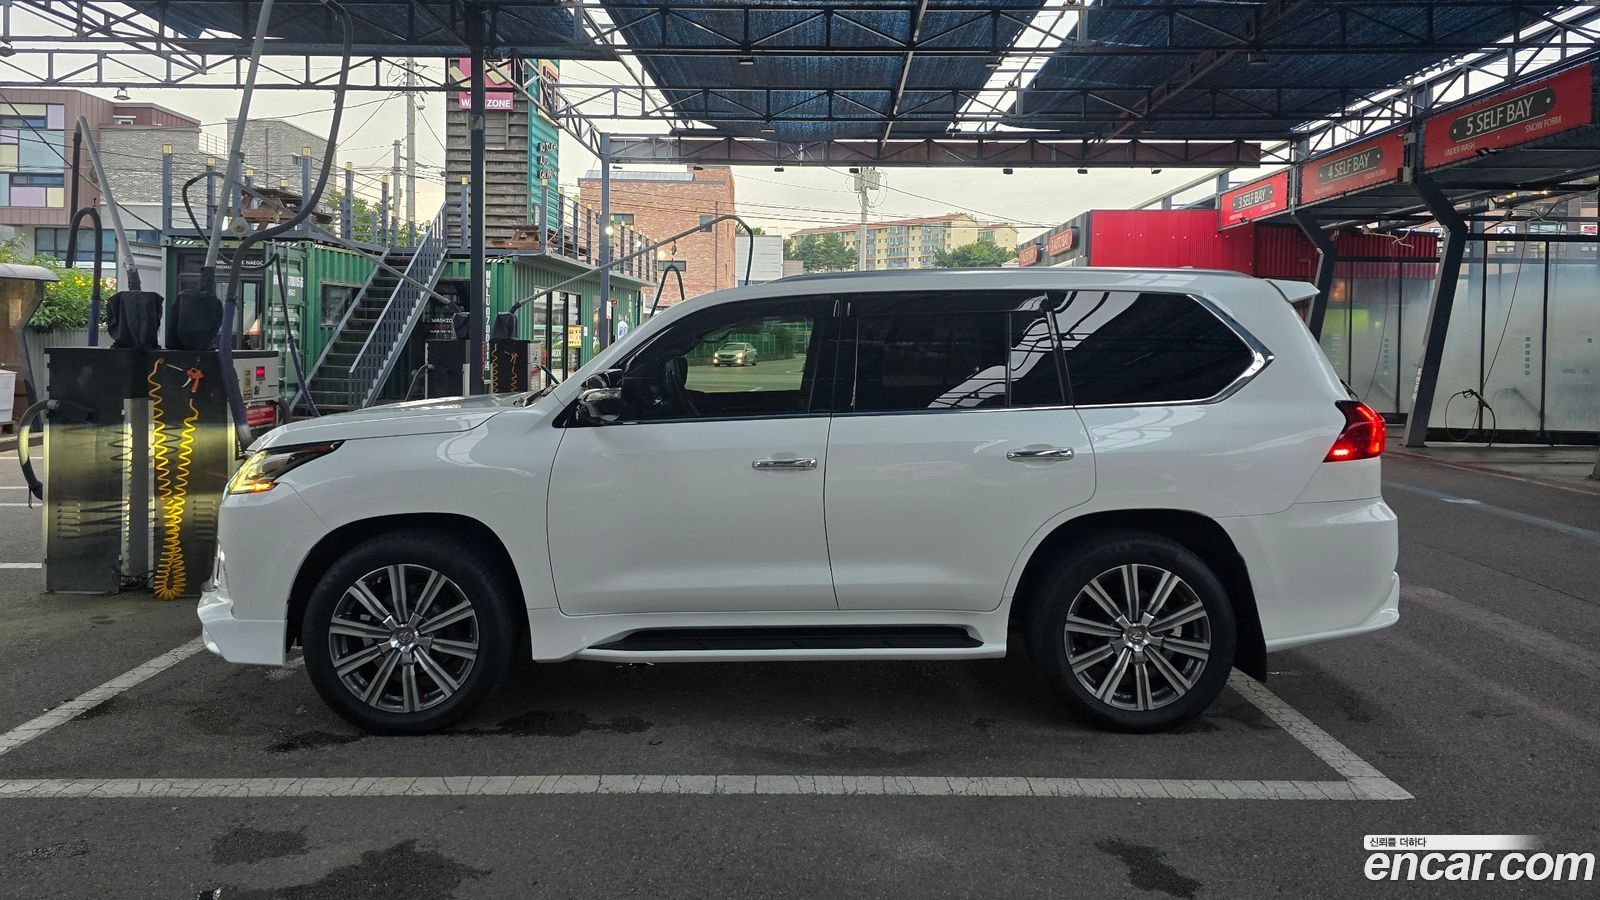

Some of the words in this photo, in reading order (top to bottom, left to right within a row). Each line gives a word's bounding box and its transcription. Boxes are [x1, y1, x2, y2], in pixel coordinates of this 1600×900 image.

[1466, 117, 1473, 136] 5
[1476, 107, 1505, 133] SELF
[1506, 96, 1534, 123] BAY
[1524, 121, 1544, 134] SNOW
[1544, 115, 1562, 127] FORM
[1444, 145, 1461, 157] UNDER
[1461, 142, 1476, 153] WASH
[1327, 165, 1333, 179] 4
[1334, 161, 1353, 178] SELF
[1353, 152, 1371, 171] BAY
[1238, 197, 1242, 209] 3
[1242, 193, 1254, 208] SELF
[1254, 188, 1266, 203] BAY
